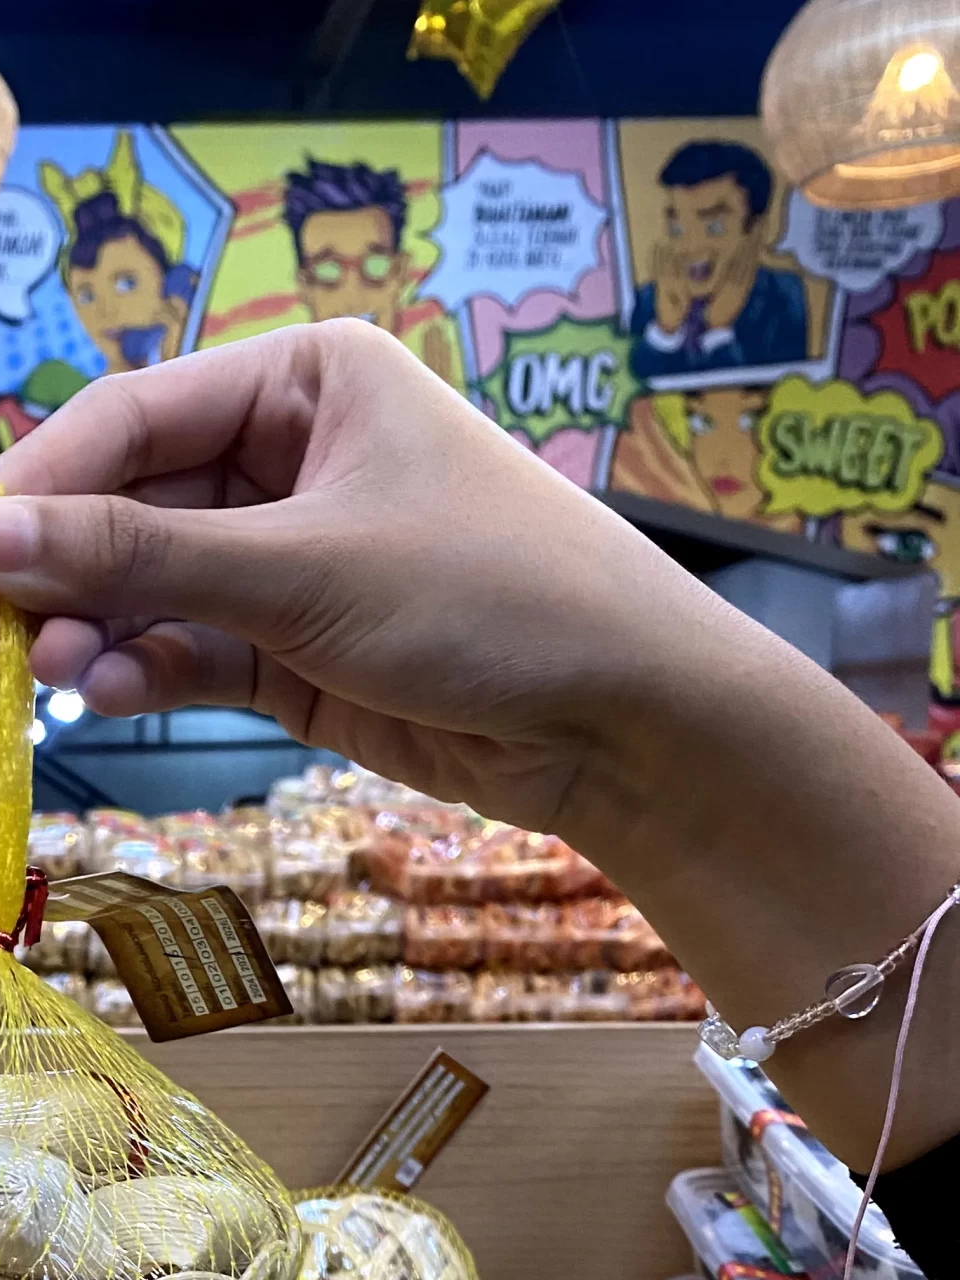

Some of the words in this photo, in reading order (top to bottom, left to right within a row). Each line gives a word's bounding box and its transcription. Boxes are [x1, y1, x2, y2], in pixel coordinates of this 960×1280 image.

[507, 352, 618, 416] OMG
[772, 411, 924, 493] SWEET
[159, 926, 175, 946] 20
[187, 918, 202, 937] 04
[221, 919, 238, 942] 2026
[198, 940, 214, 961] 03
[181, 972, 196, 991] 10
[209, 963, 224, 984] 02
[221, 988, 235, 1006] 01
[248, 978, 265, 999] 2024
[192, 995, 208, 1015] 05
